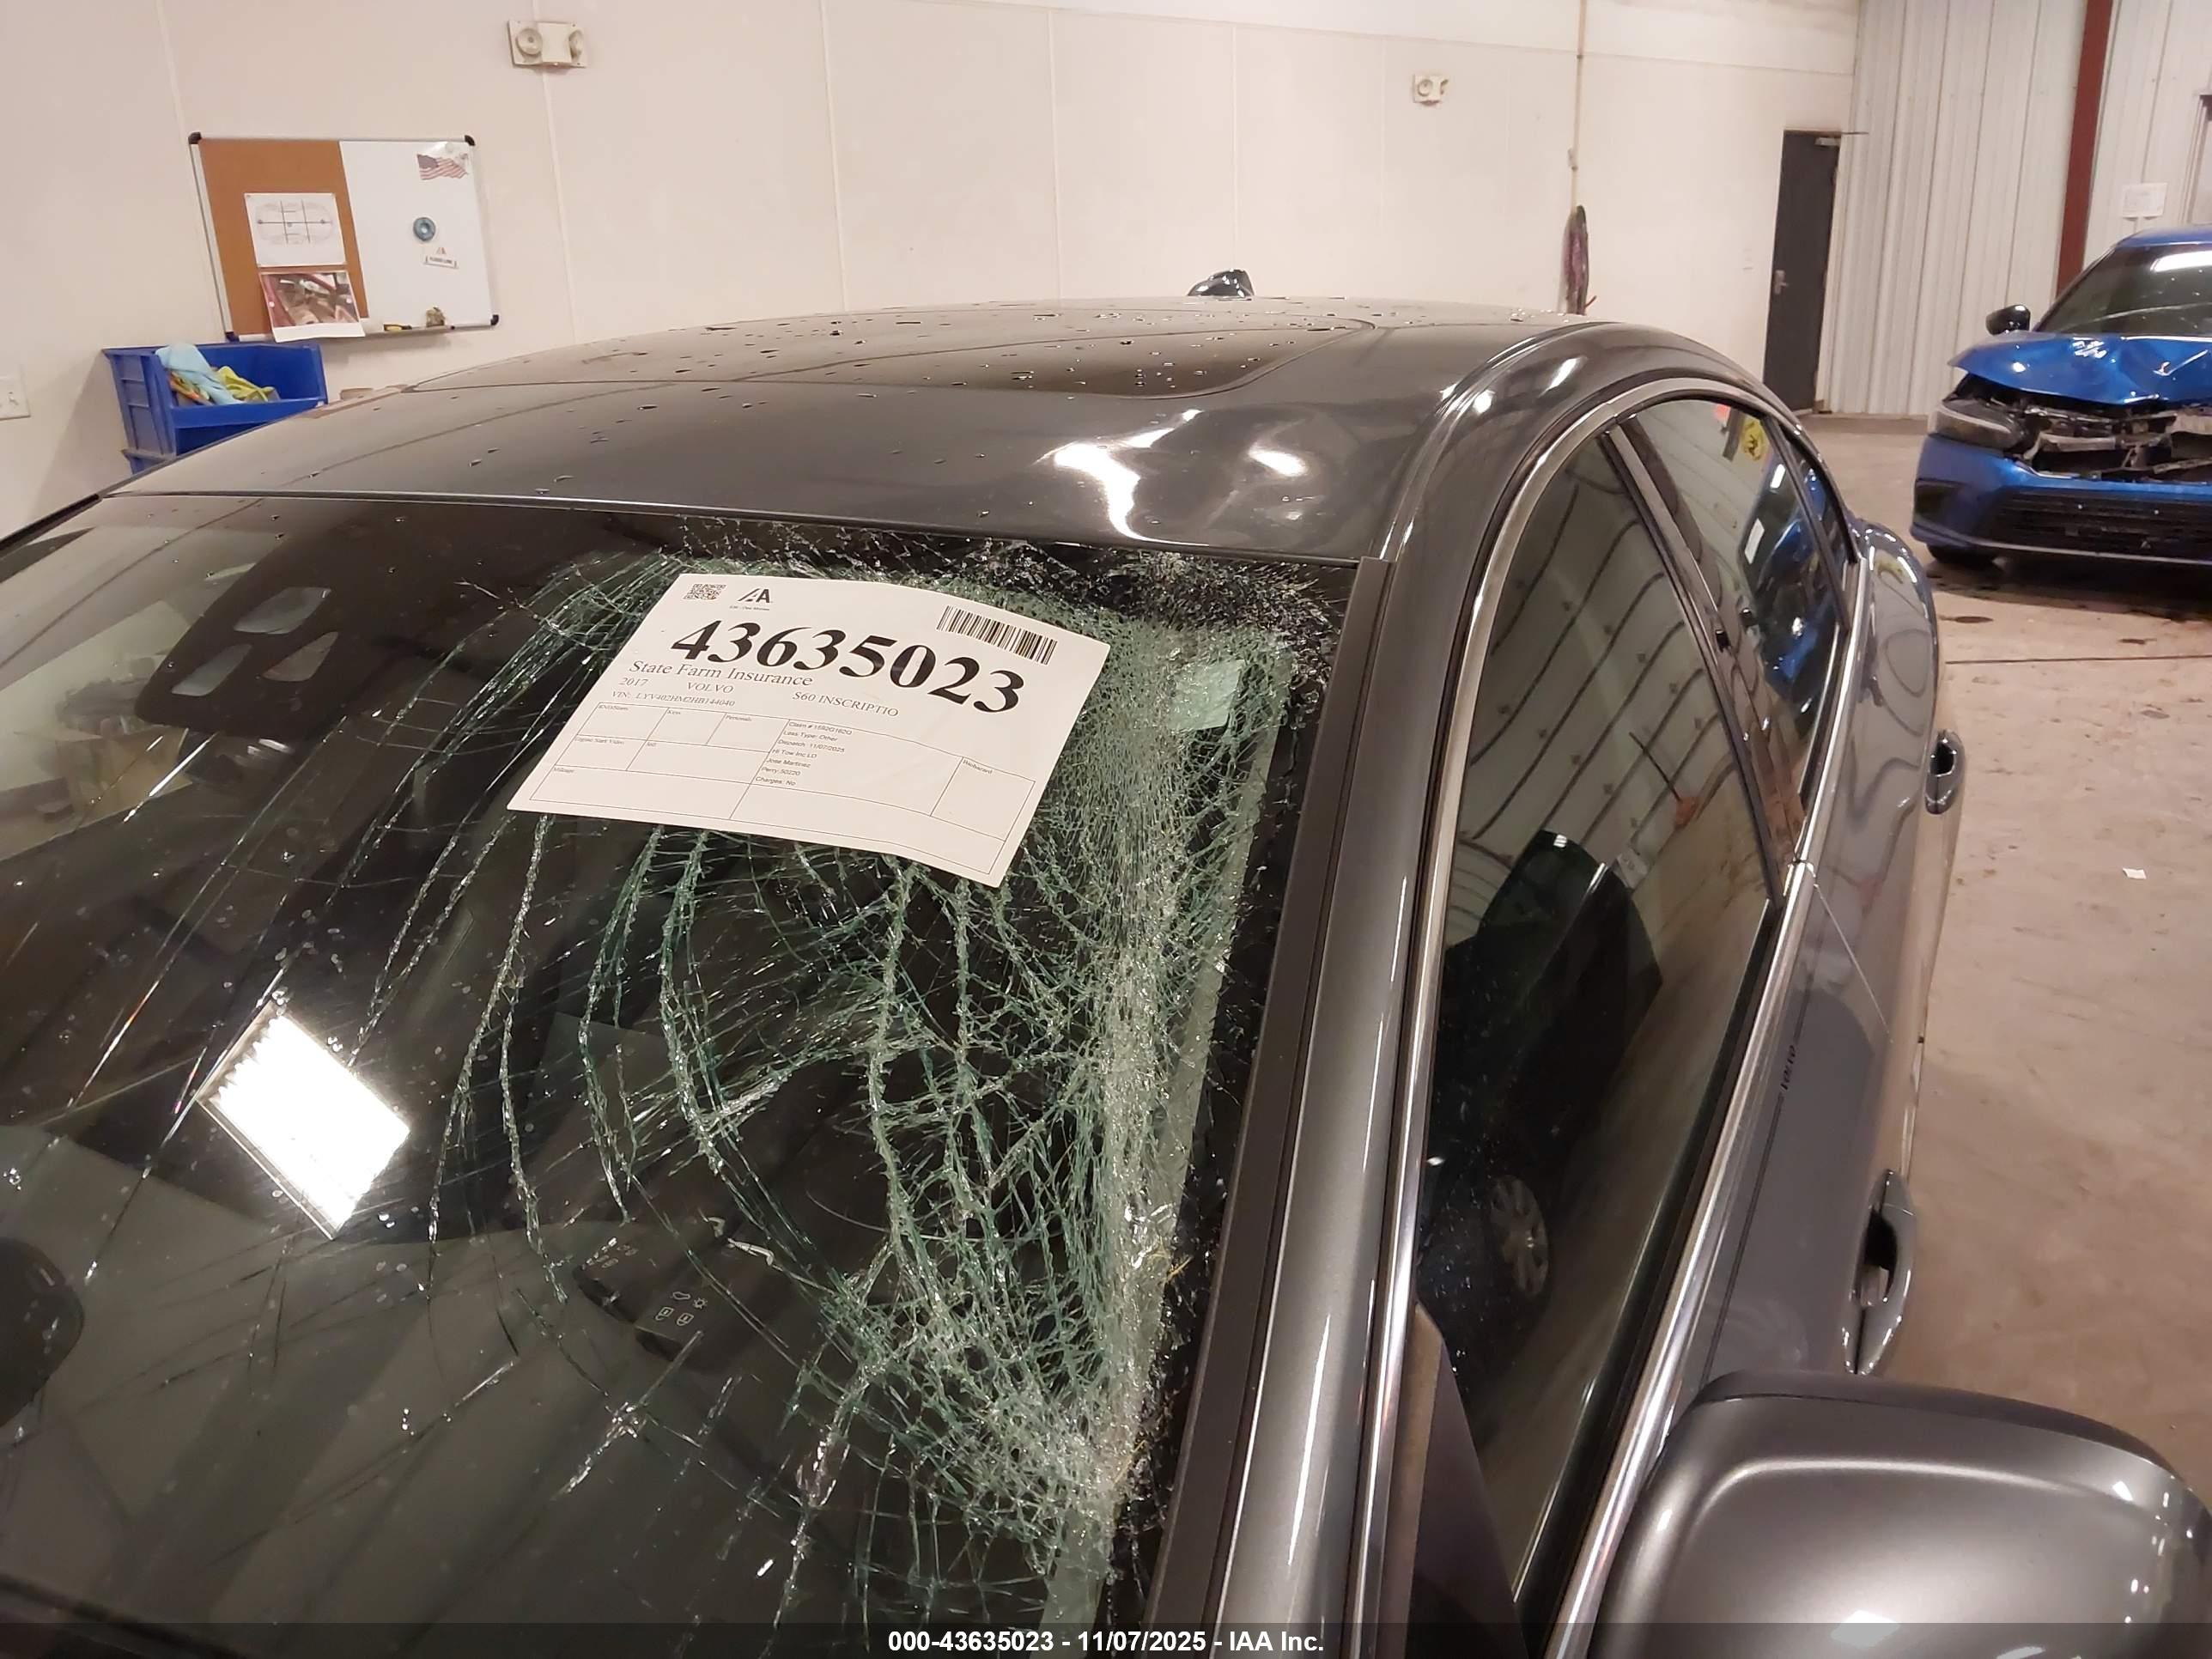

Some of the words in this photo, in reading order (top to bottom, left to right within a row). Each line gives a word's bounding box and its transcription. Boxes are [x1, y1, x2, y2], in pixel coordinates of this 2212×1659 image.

[629, 660, 672, 674] State
[677, 664, 721, 678] Farm
[726, 667, 813, 686] Insurance
[670, 619, 1025, 714] 43635023
[618, 677, 648, 687] 2017
[687, 682, 734, 694] VOLVO
[793, 691, 816, 702] S60
[818, 695, 899, 716] INSCRIPTIO
